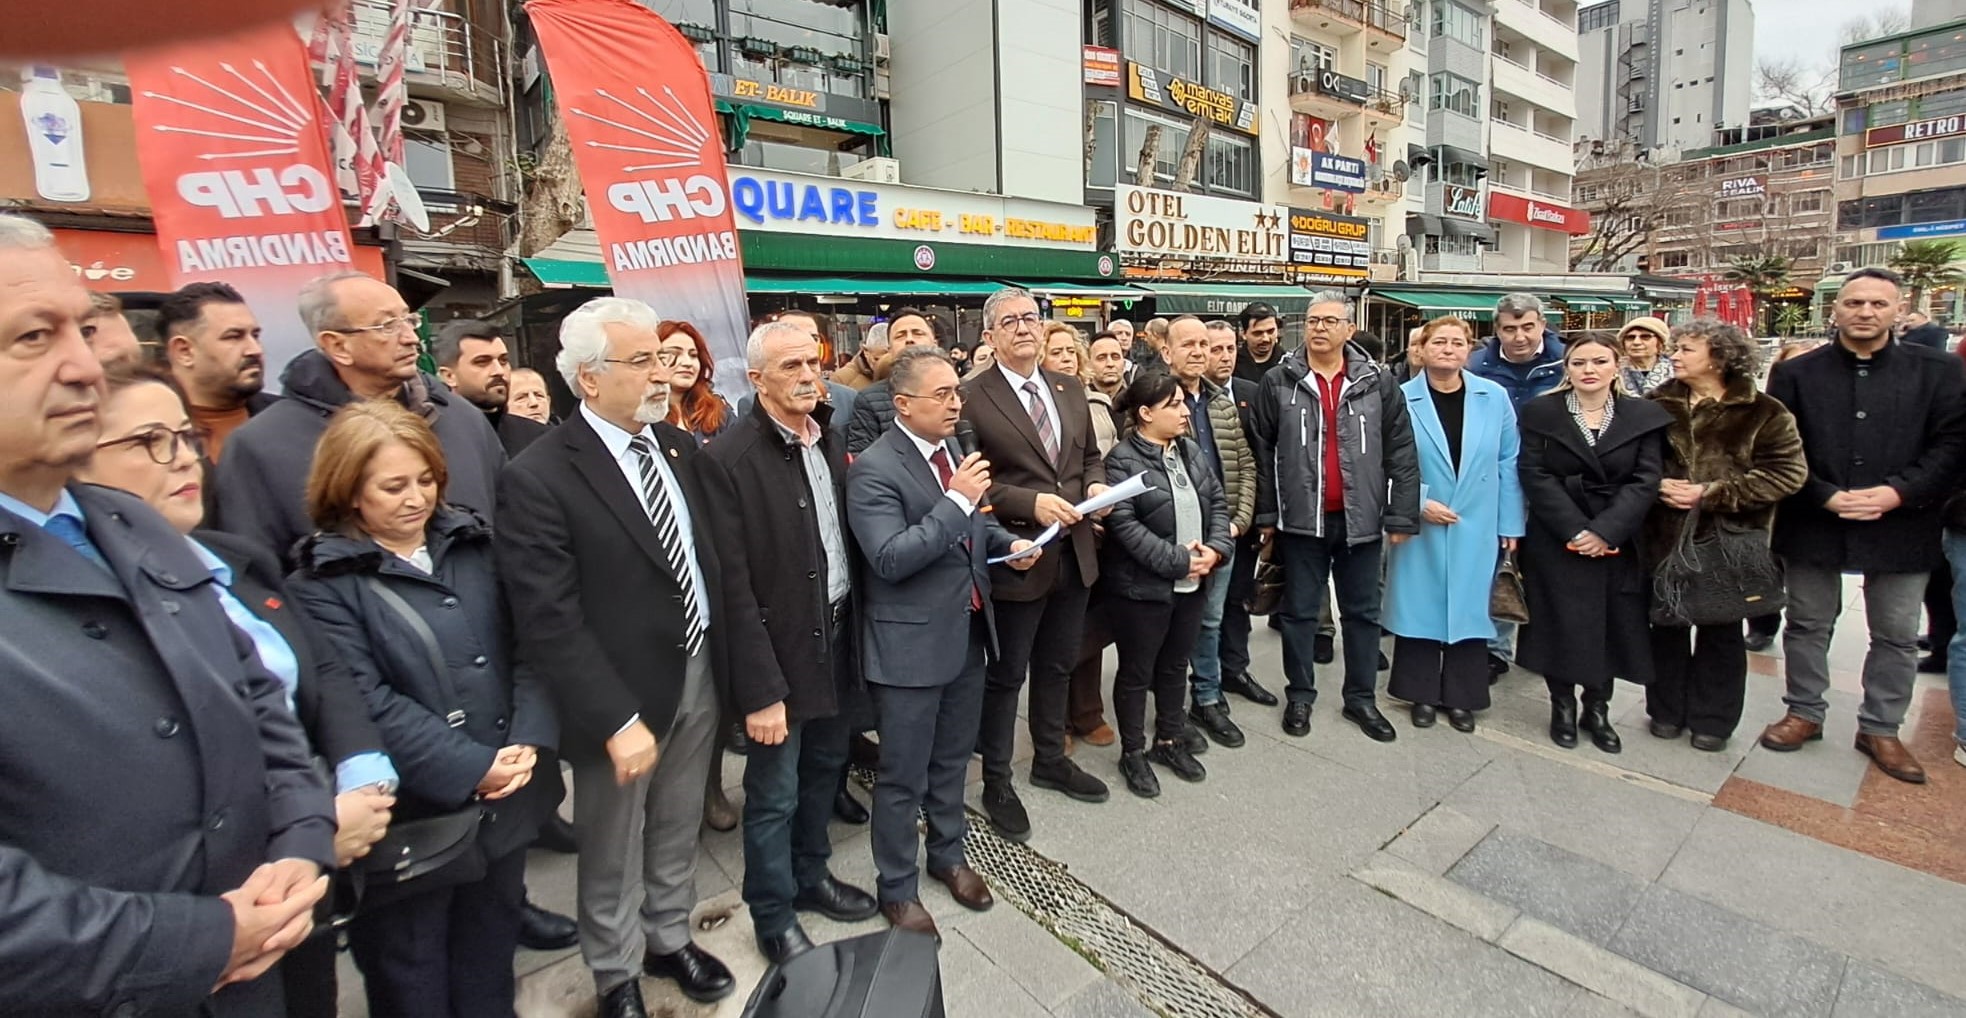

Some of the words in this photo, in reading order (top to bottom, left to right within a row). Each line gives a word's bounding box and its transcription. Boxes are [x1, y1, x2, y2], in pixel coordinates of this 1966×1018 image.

[766, 85, 816, 107] BALIK
[783, 110, 812, 122] SQUARE
[1905, 117, 1959, 139] RETRO
[1321, 157, 1334, 169] AK
[732, 176, 879, 226] QUARE
[1127, 190, 1188, 219] OTEL
[893, 208, 942, 231] CAFE
[958, 213, 995, 236] BAR
[1300, 215, 1337, 232] DOĞRU
[1338, 222, 1366, 236] GRUP
[1127, 218, 1231, 253] GOLDEN
[1236, 227, 1284, 256] ELİT
